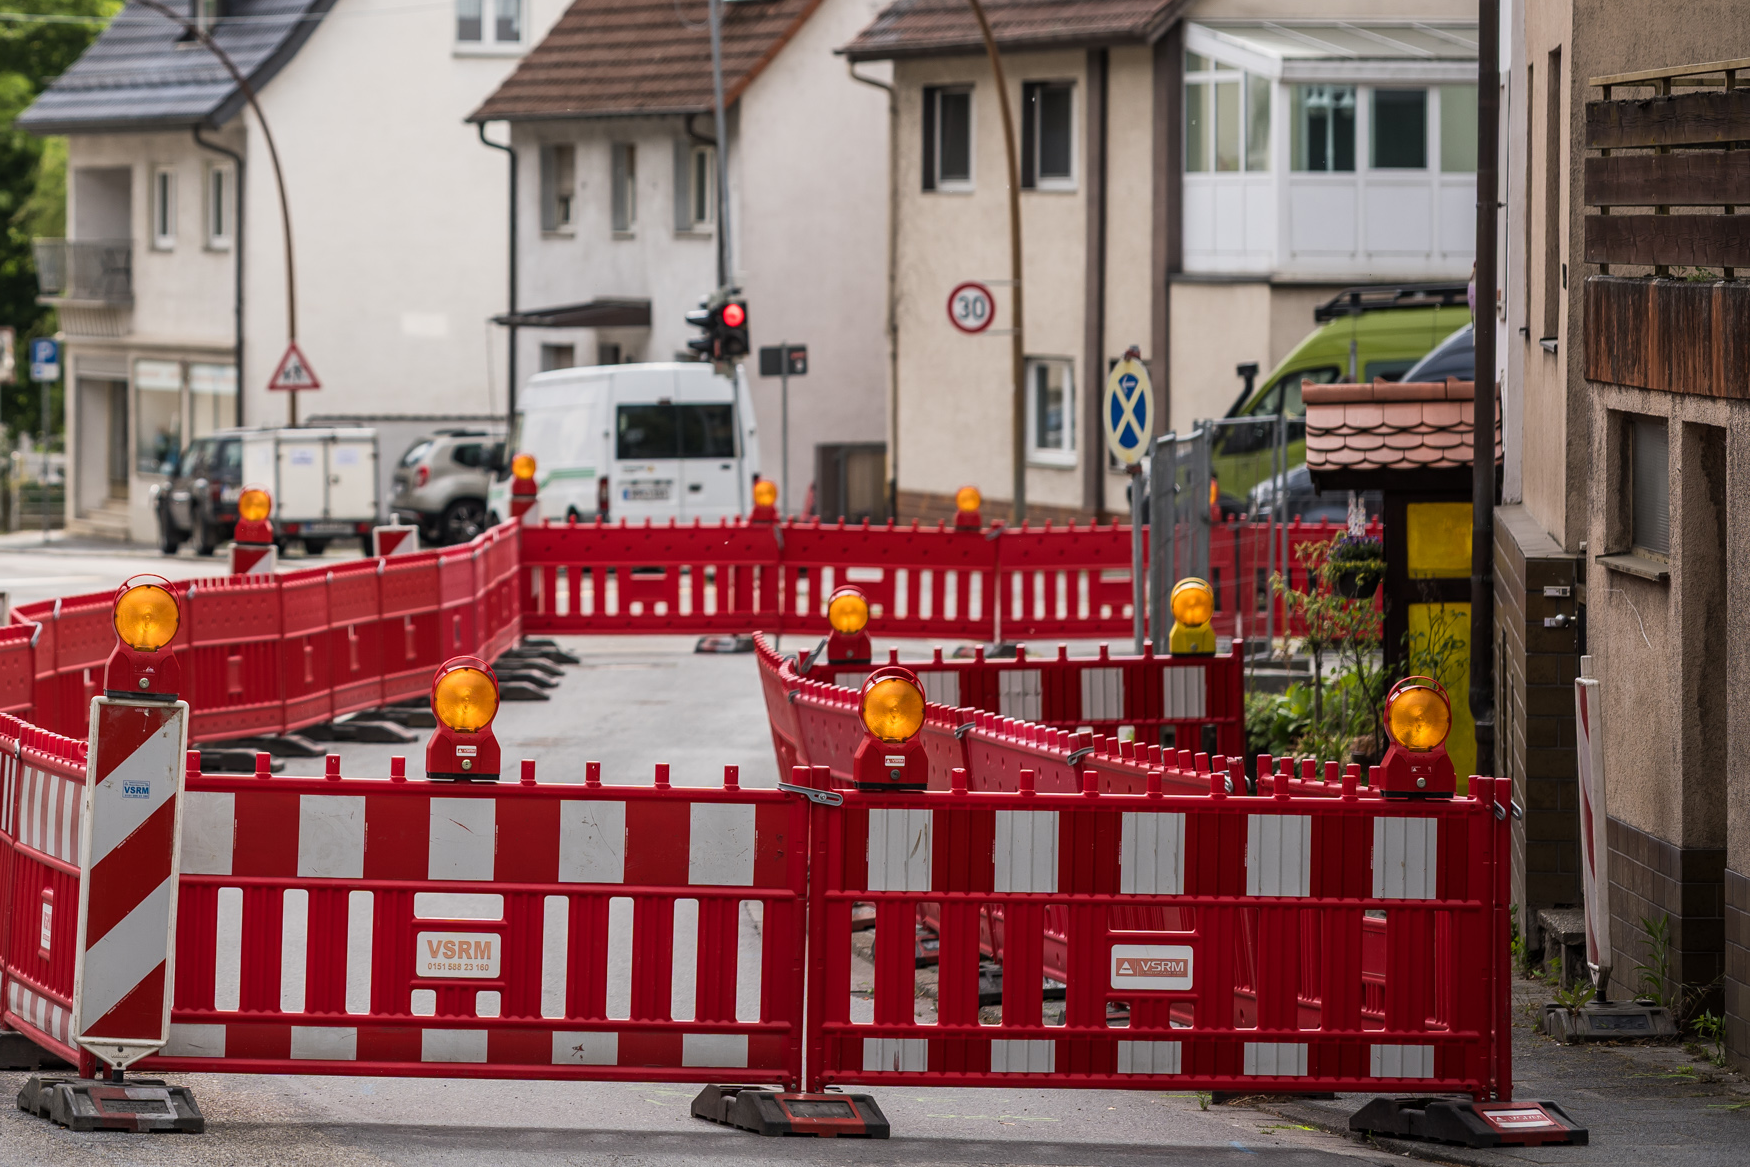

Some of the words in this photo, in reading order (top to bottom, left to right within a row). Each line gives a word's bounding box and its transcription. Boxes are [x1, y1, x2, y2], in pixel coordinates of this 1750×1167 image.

[958, 295, 986, 321] 30
[37, 341, 54, 363] P
[124, 786, 149, 794] VSRM
[426, 939, 492, 960] VSRM
[427, 962, 446, 970] 0151
[448, 962, 462, 971] 588
[464, 963, 474, 971] 23
[476, 963, 489, 971] 160
[1140, 960, 1184, 972] VSRM
